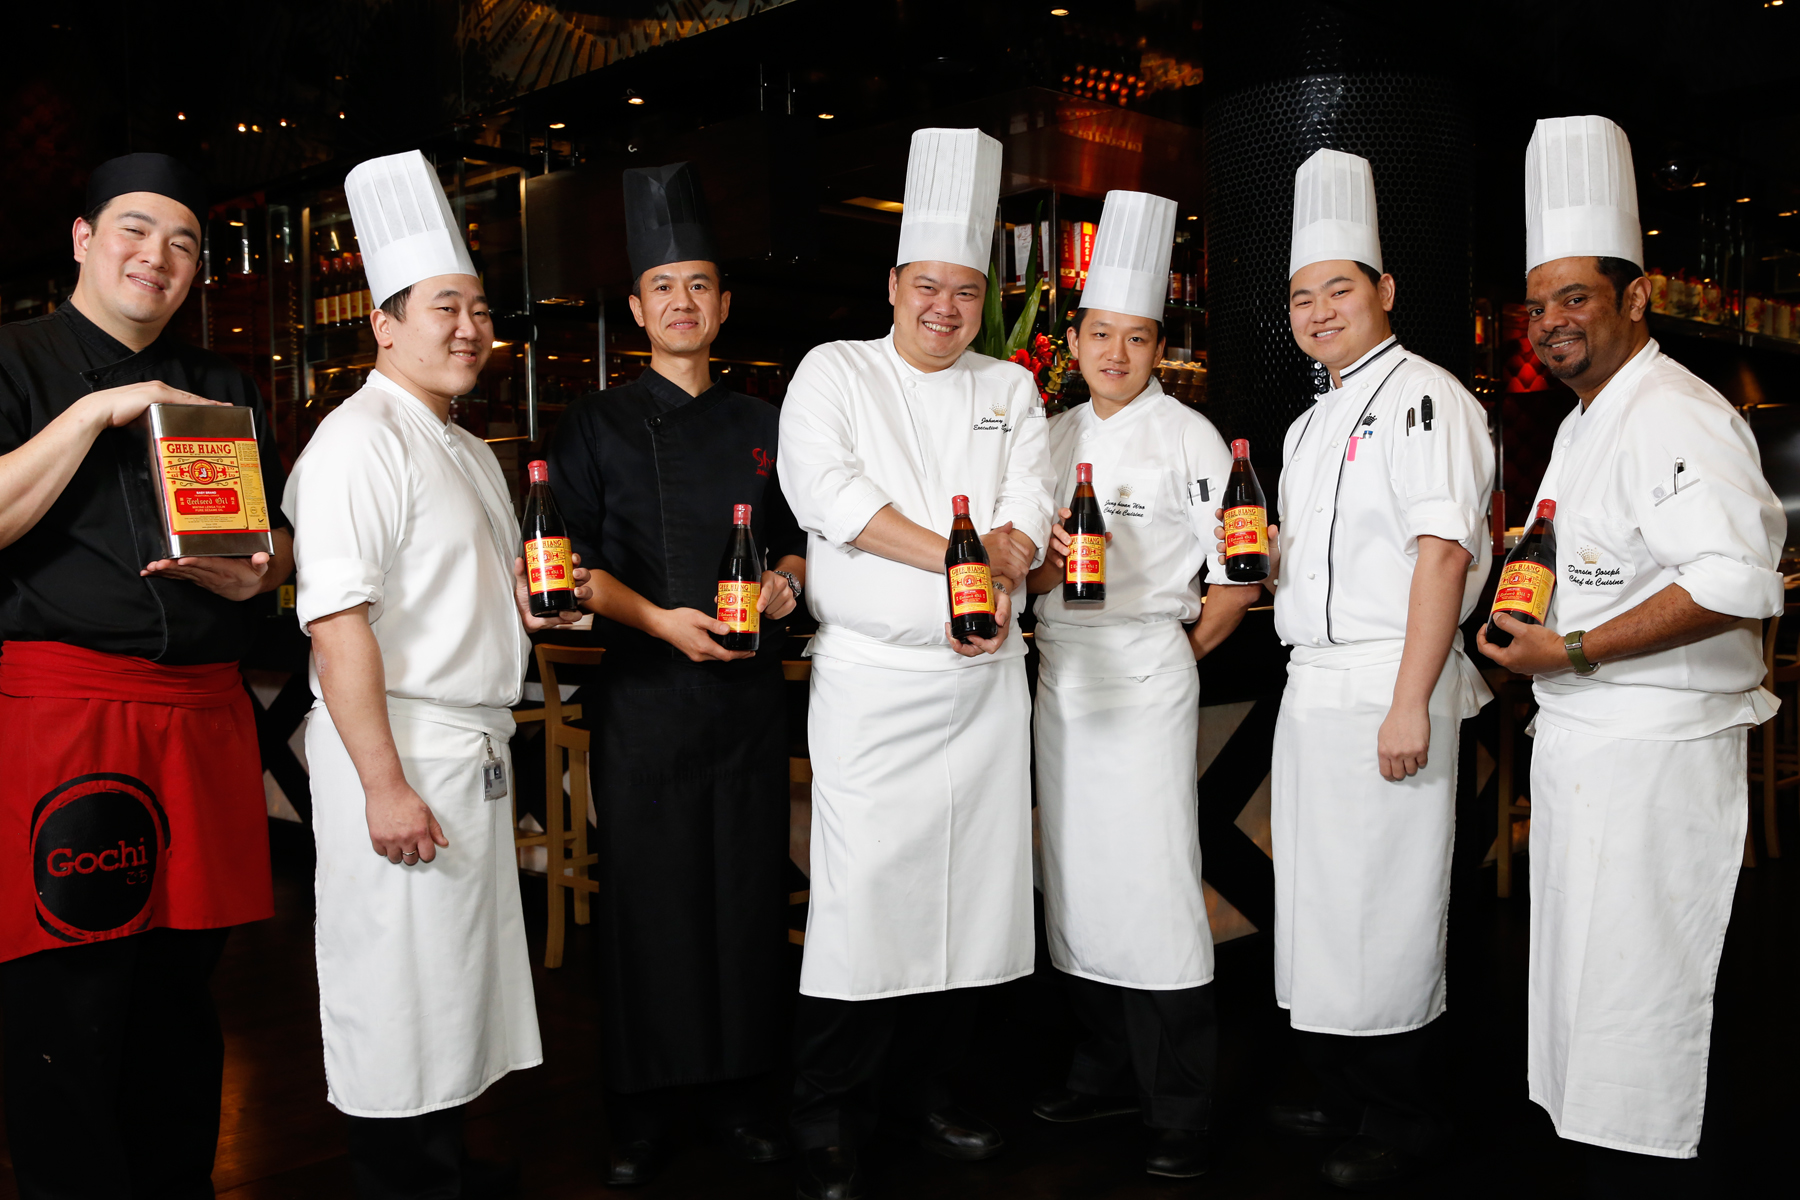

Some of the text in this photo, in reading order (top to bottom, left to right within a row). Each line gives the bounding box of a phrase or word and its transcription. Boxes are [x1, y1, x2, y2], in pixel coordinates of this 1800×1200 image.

[166, 443, 195, 454] GHEE
[198, 444, 231, 454] HIANG
[215, 497, 228, 505] Oil
[1517, 563, 1541, 573] HIANG
[1594, 567, 1620, 578] Joseph
[1568, 574, 1625, 587] Chef de Cuisine
[46, 837, 149, 877] Gochi
[126, 869, 148, 885] ごち
